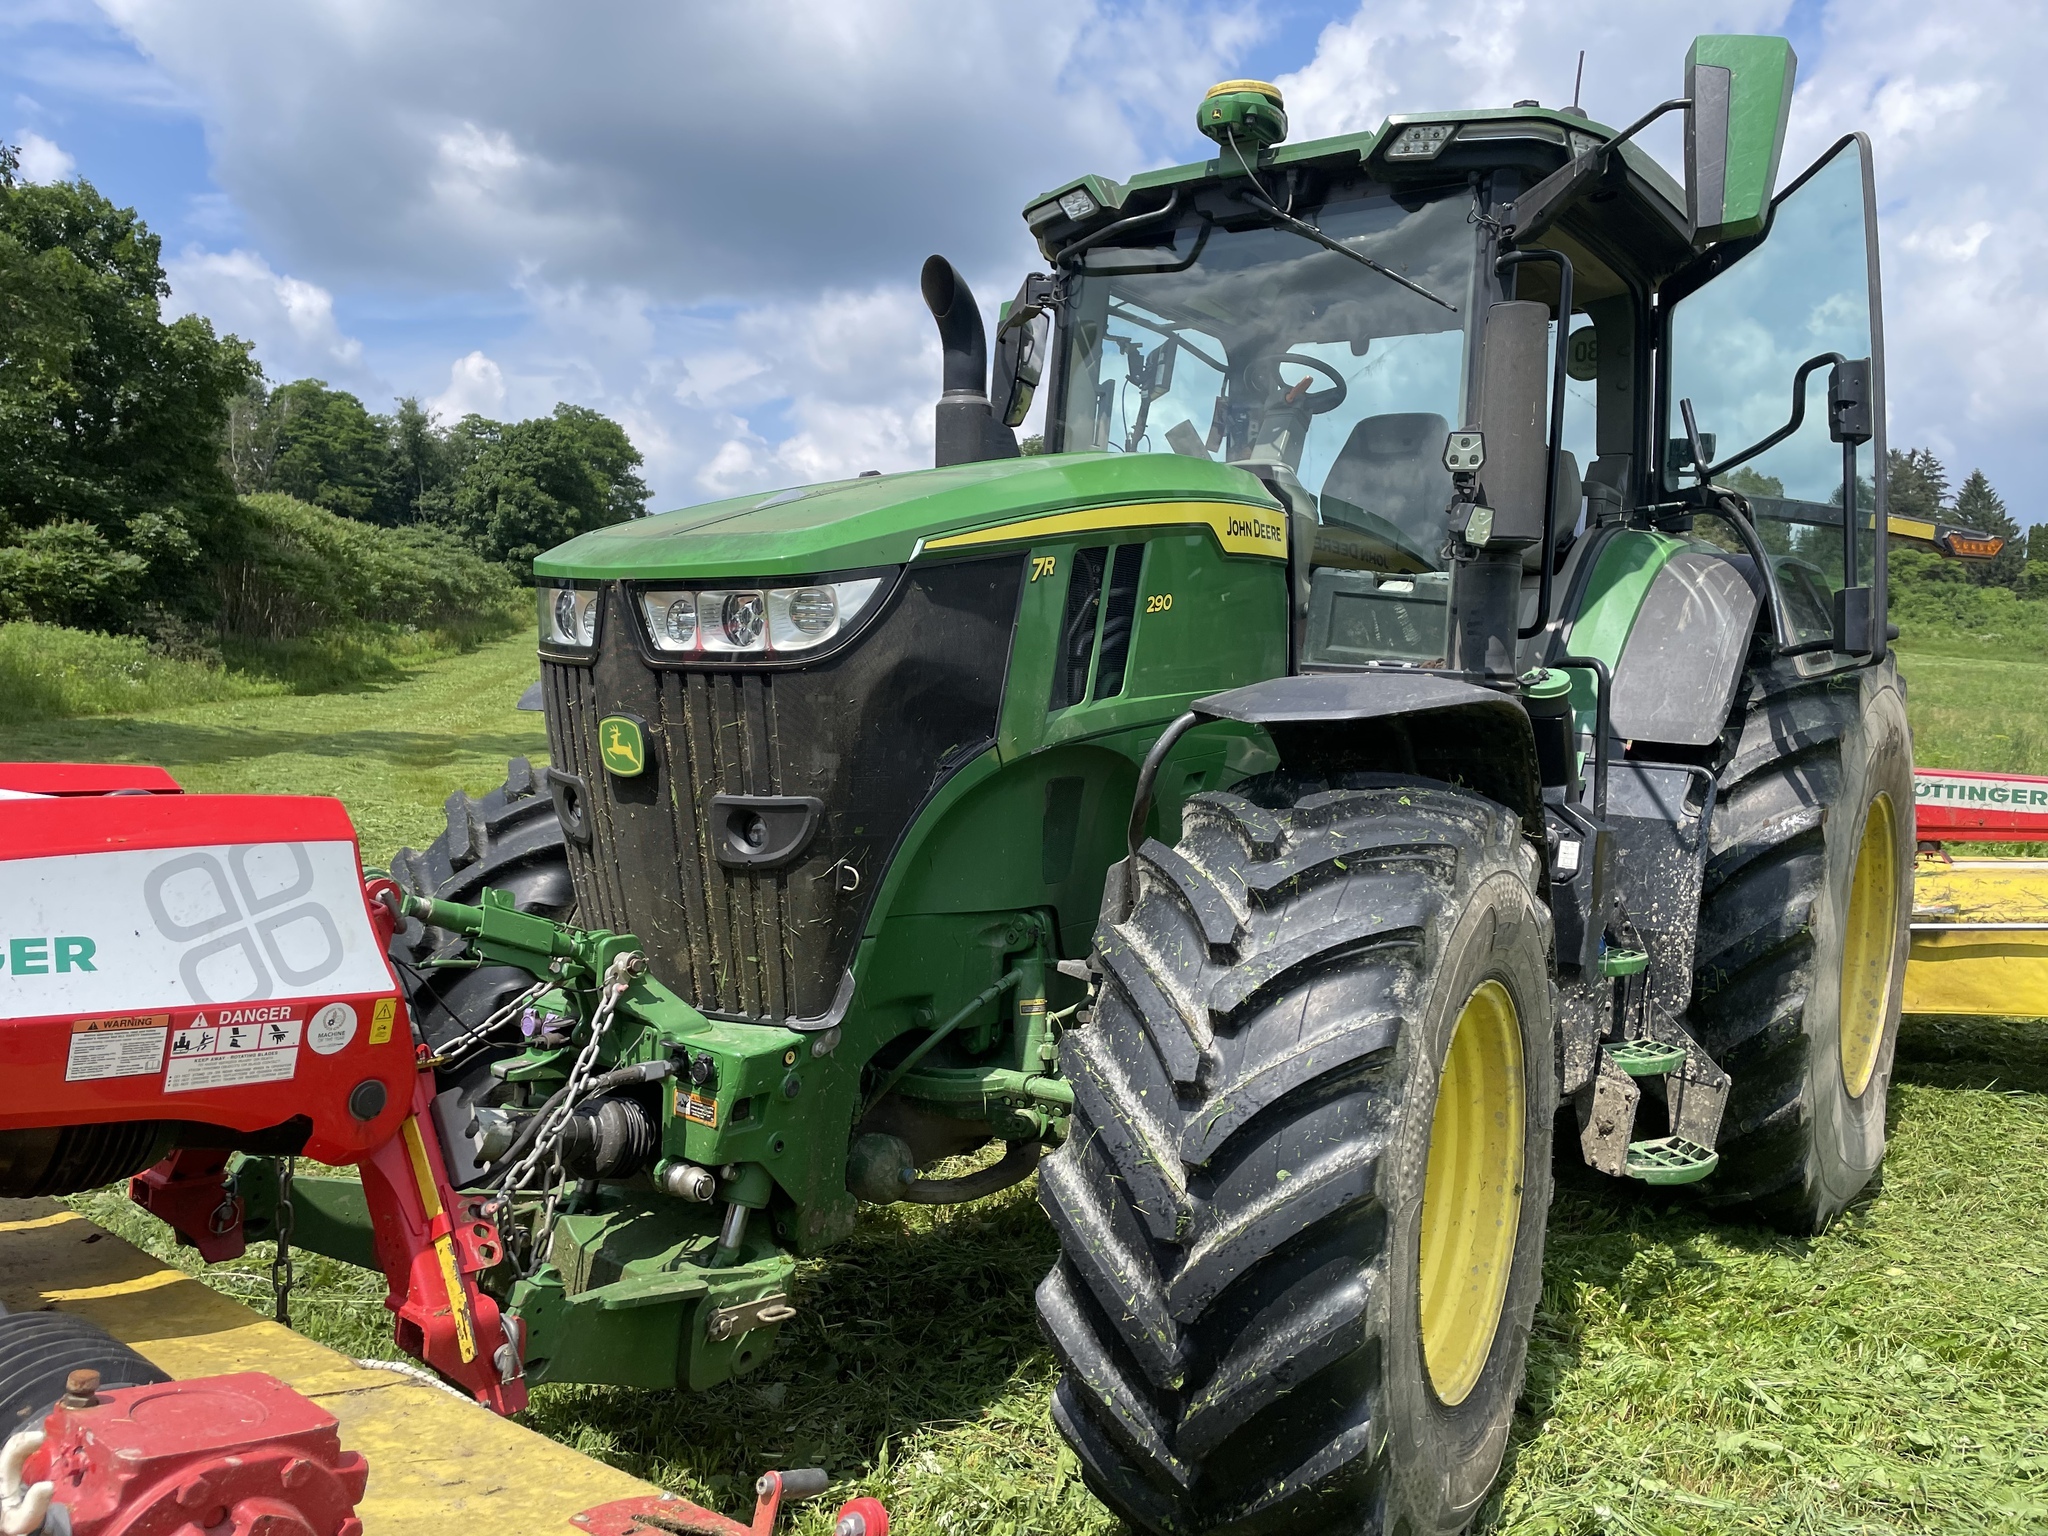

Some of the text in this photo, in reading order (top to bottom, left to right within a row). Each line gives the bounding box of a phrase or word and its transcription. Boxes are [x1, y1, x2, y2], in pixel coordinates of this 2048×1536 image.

[1226, 515, 1282, 542] JOHN DEERE
[1030, 555, 1056, 583] 7R
[1146, 593, 1173, 614] 290
[1914, 782, 2048, 805] ÖTTINGER
[0, 935, 98, 976] ER
[103, 1018, 152, 1028] WARNING
[219, 1006, 291, 1025] DANGER
